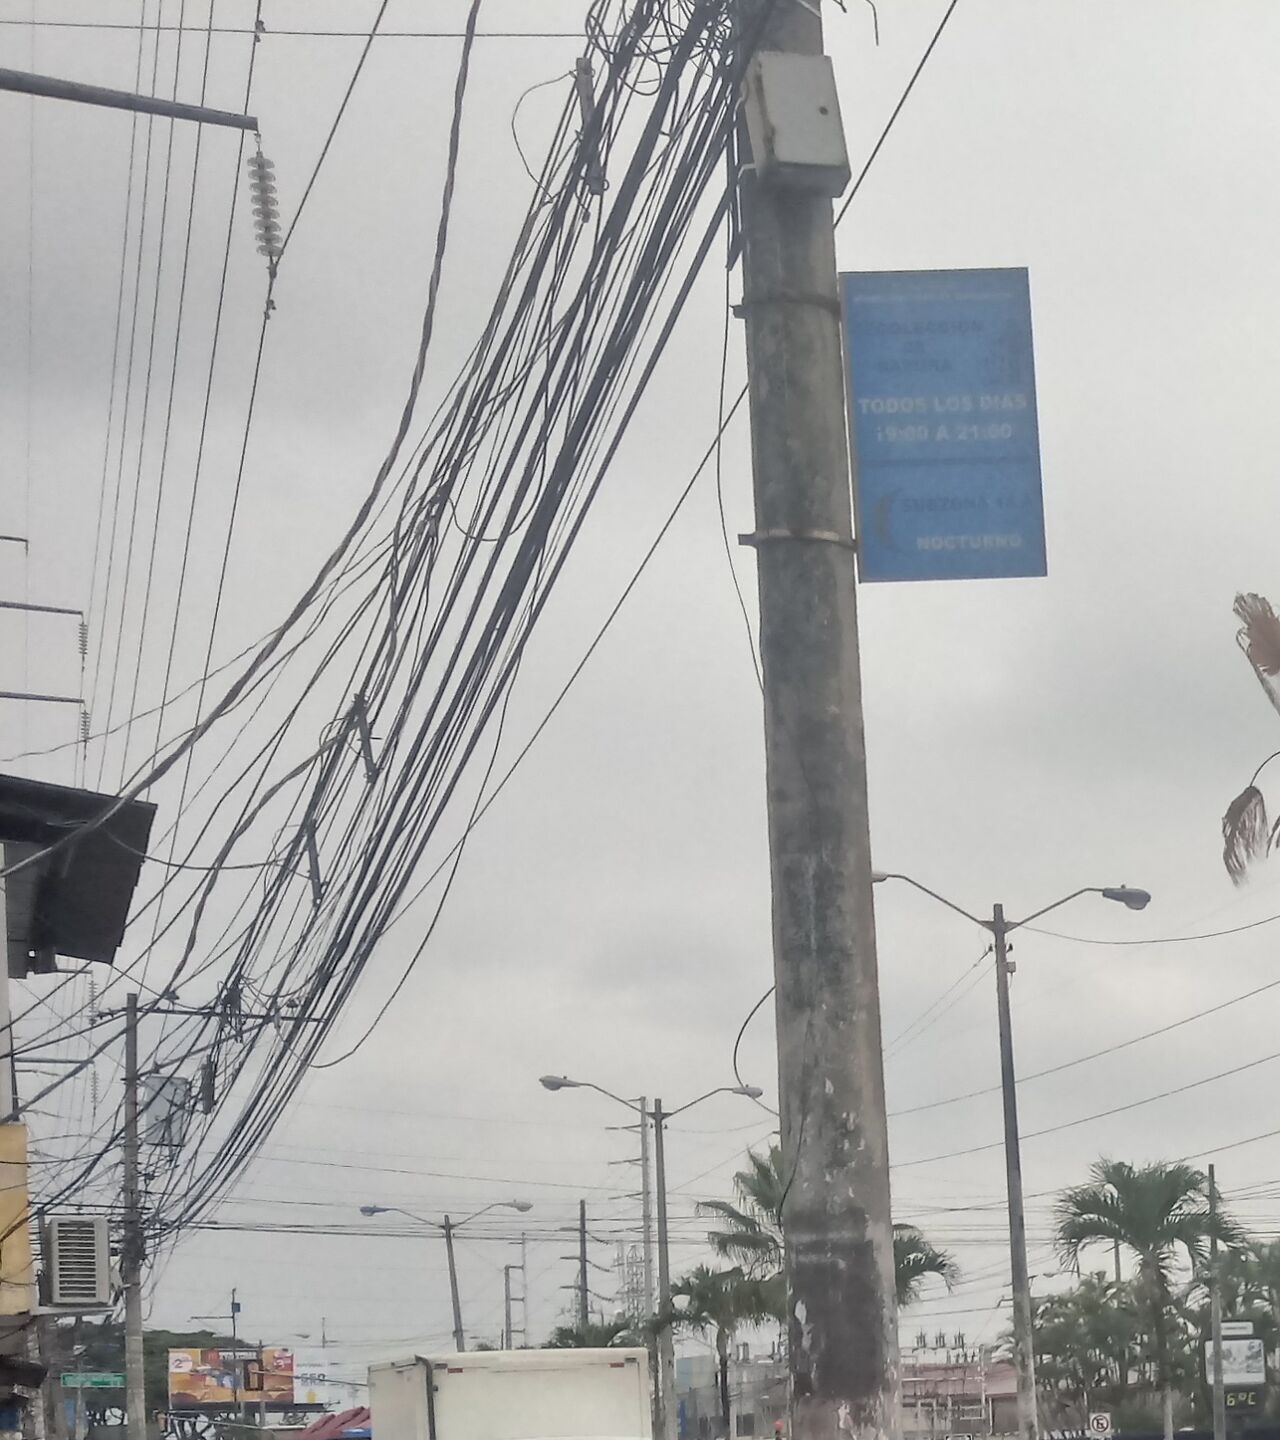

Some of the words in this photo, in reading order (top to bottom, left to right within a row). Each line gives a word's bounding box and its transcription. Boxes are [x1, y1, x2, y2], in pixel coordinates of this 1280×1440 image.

[858, 396, 927, 414] TODOS
[933, 394, 972, 412] LOS
[979, 393, 1027, 410] DIAS
[935, 424, 950, 441] A
[956, 423, 1012, 440] 21:00
[916, 534, 1022, 551] NOCTURNO
